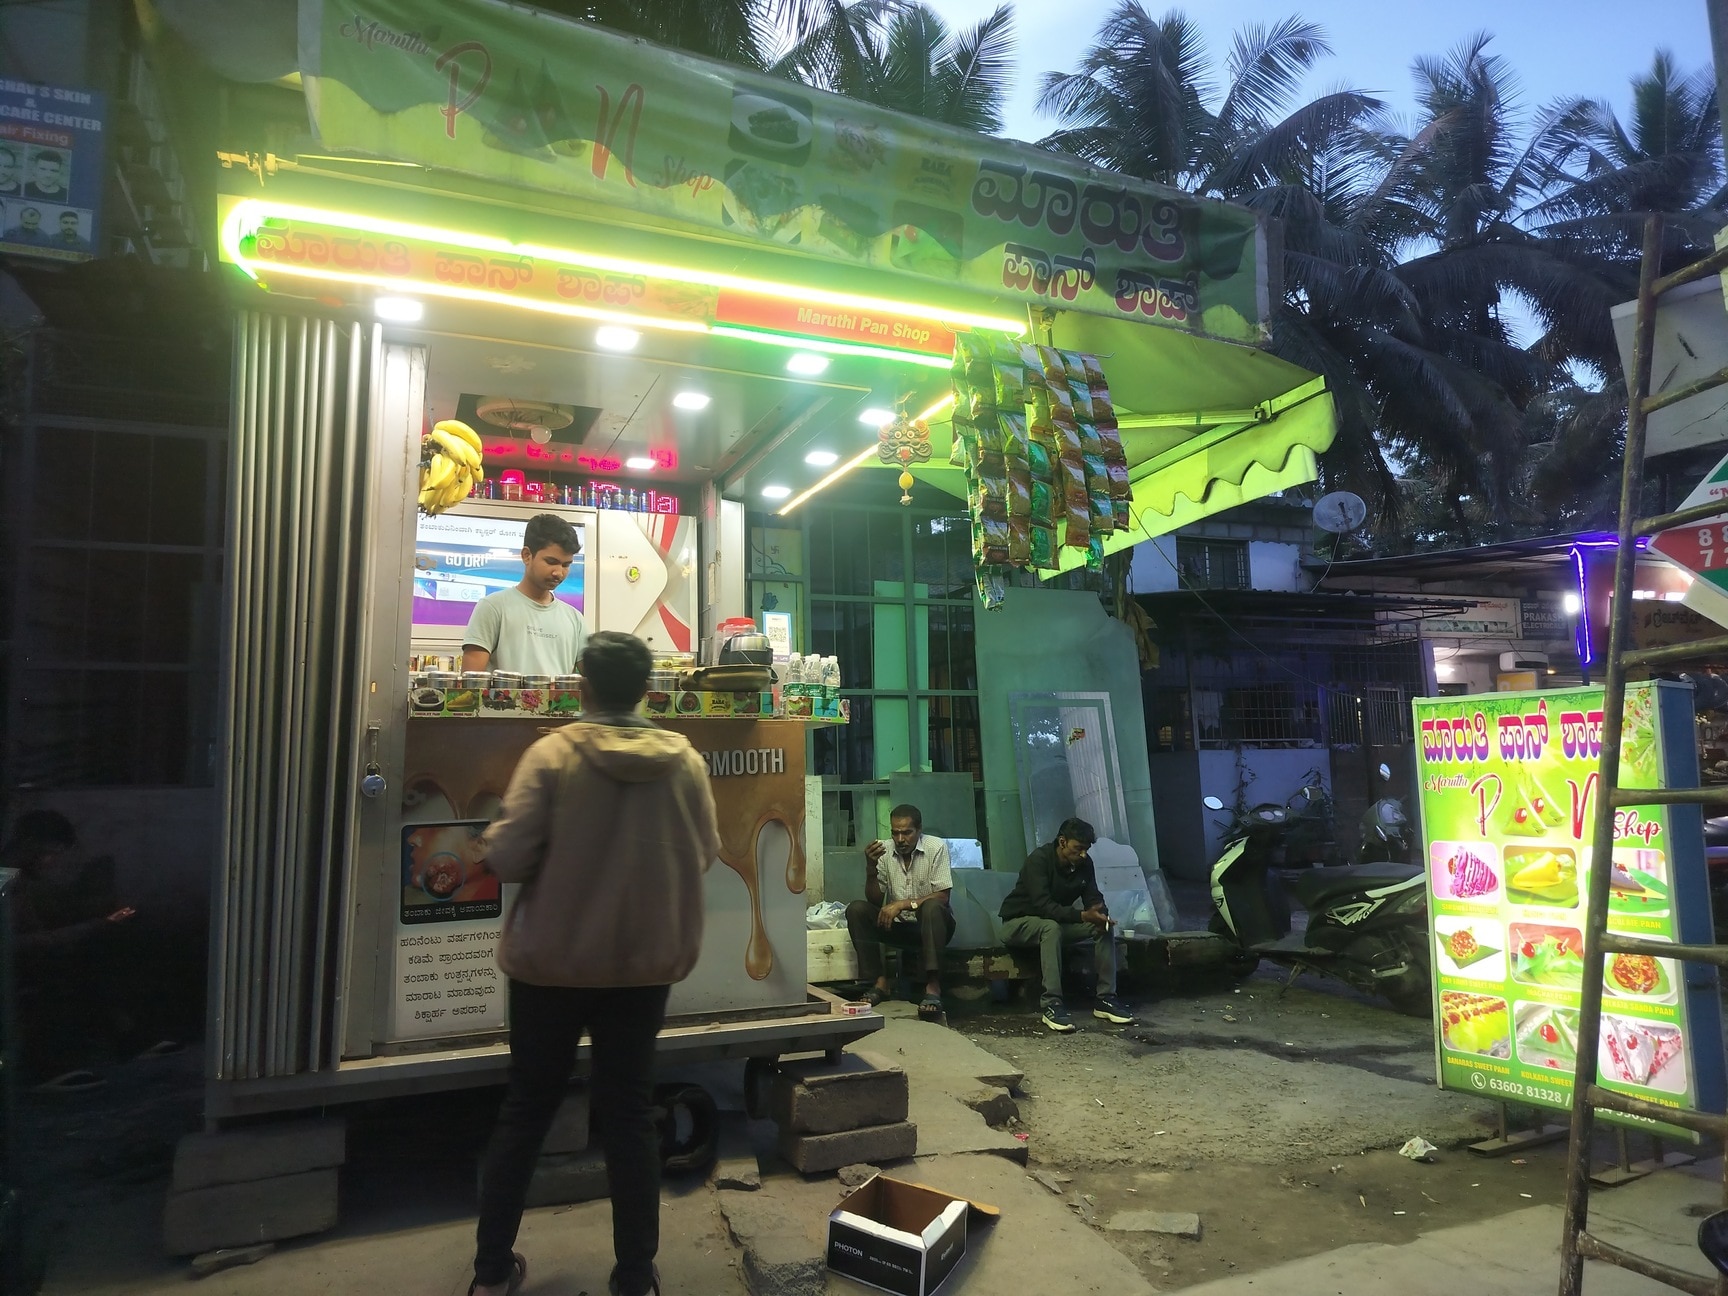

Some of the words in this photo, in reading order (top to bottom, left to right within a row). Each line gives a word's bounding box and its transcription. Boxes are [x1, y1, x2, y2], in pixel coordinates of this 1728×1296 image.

[339, 14, 431, 54] Maruthi
[25, 98, 37, 108] &
[53, 88, 91, 105] SKIN
[43, 112, 103, 132] CENTER
[23, 127, 69, 146] Fixing
[654, 154, 717, 199] Shop
[971, 158, 1186, 263] ಮಾರುತಿ
[255, 219, 413, 276] ಮಾರುತಿ
[434, 250, 535, 291] ಪಾನ್
[556, 265, 648, 306] ಶಾಪ್
[1002, 241, 1097, 303] ಪಾನ್
[1114, 267, 1200, 322] ಶಾಪ್
[797, 307, 857, 331] Maruthi
[859, 317, 889, 336] Pan
[892, 322, 930, 345] Shop
[445, 553, 462, 567] GO
[1523, 612, 1564, 622] PRAKASH
[1421, 709, 1489, 763] ಮಾರುತಿ
[1498, 698, 1549, 761] ಪಾನ್
[701, 748, 784, 776] SMOOTH
[1424, 773, 1468, 794] Maruthi
[1612, 808, 1661, 845] Shop
[404, 908, 432, 918] ತಂಬಾಕು
[1640, 920, 1662, 929] PAAN
[400, 936, 442, 947] ಹದಿನೆಂಟು
[447, 930, 502, 943] ವರ್ಷಗಳಿಗಿಂತ
[408, 953, 433, 965] ಕಡಿಮೆ
[439, 948, 494, 964] ಪ್ರಾಯದವರಿಗೆ
[404, 972, 438, 983] ತಂಬಾಕು
[444, 967, 497, 983] ಉತ್ಪನ್ನಗಳನ್ನು
[405, 990, 441, 1002] ಮಾರಾಟ
[447, 985, 496, 998] ಮಾಡುವುದು
[414, 1008, 447, 1023] ಶಿಕ್ಷಾರ್ಹ
[452, 1003, 487, 1016] ಅಪರಾಧ
[1602, 999, 1628, 1009] OLKATA
[1654, 1005, 1675, 1016] PAAN
[1447, 1056, 1473, 1069] BANARAS
[1474, 1060, 1493, 1073] SWEET
[1493, 1063, 1510, 1075] PAAN
[1521, 1070, 1549, 1084] KOLKATA
[1550, 1075, 1573, 1088] SWEET
[1489, 1078, 1524, 1096] 63602
[1526, 1086, 1562, 1104] 81328
[1659, 1098, 1680, 1109] PAAN
[834, 1241, 863, 1257] PHOTON
